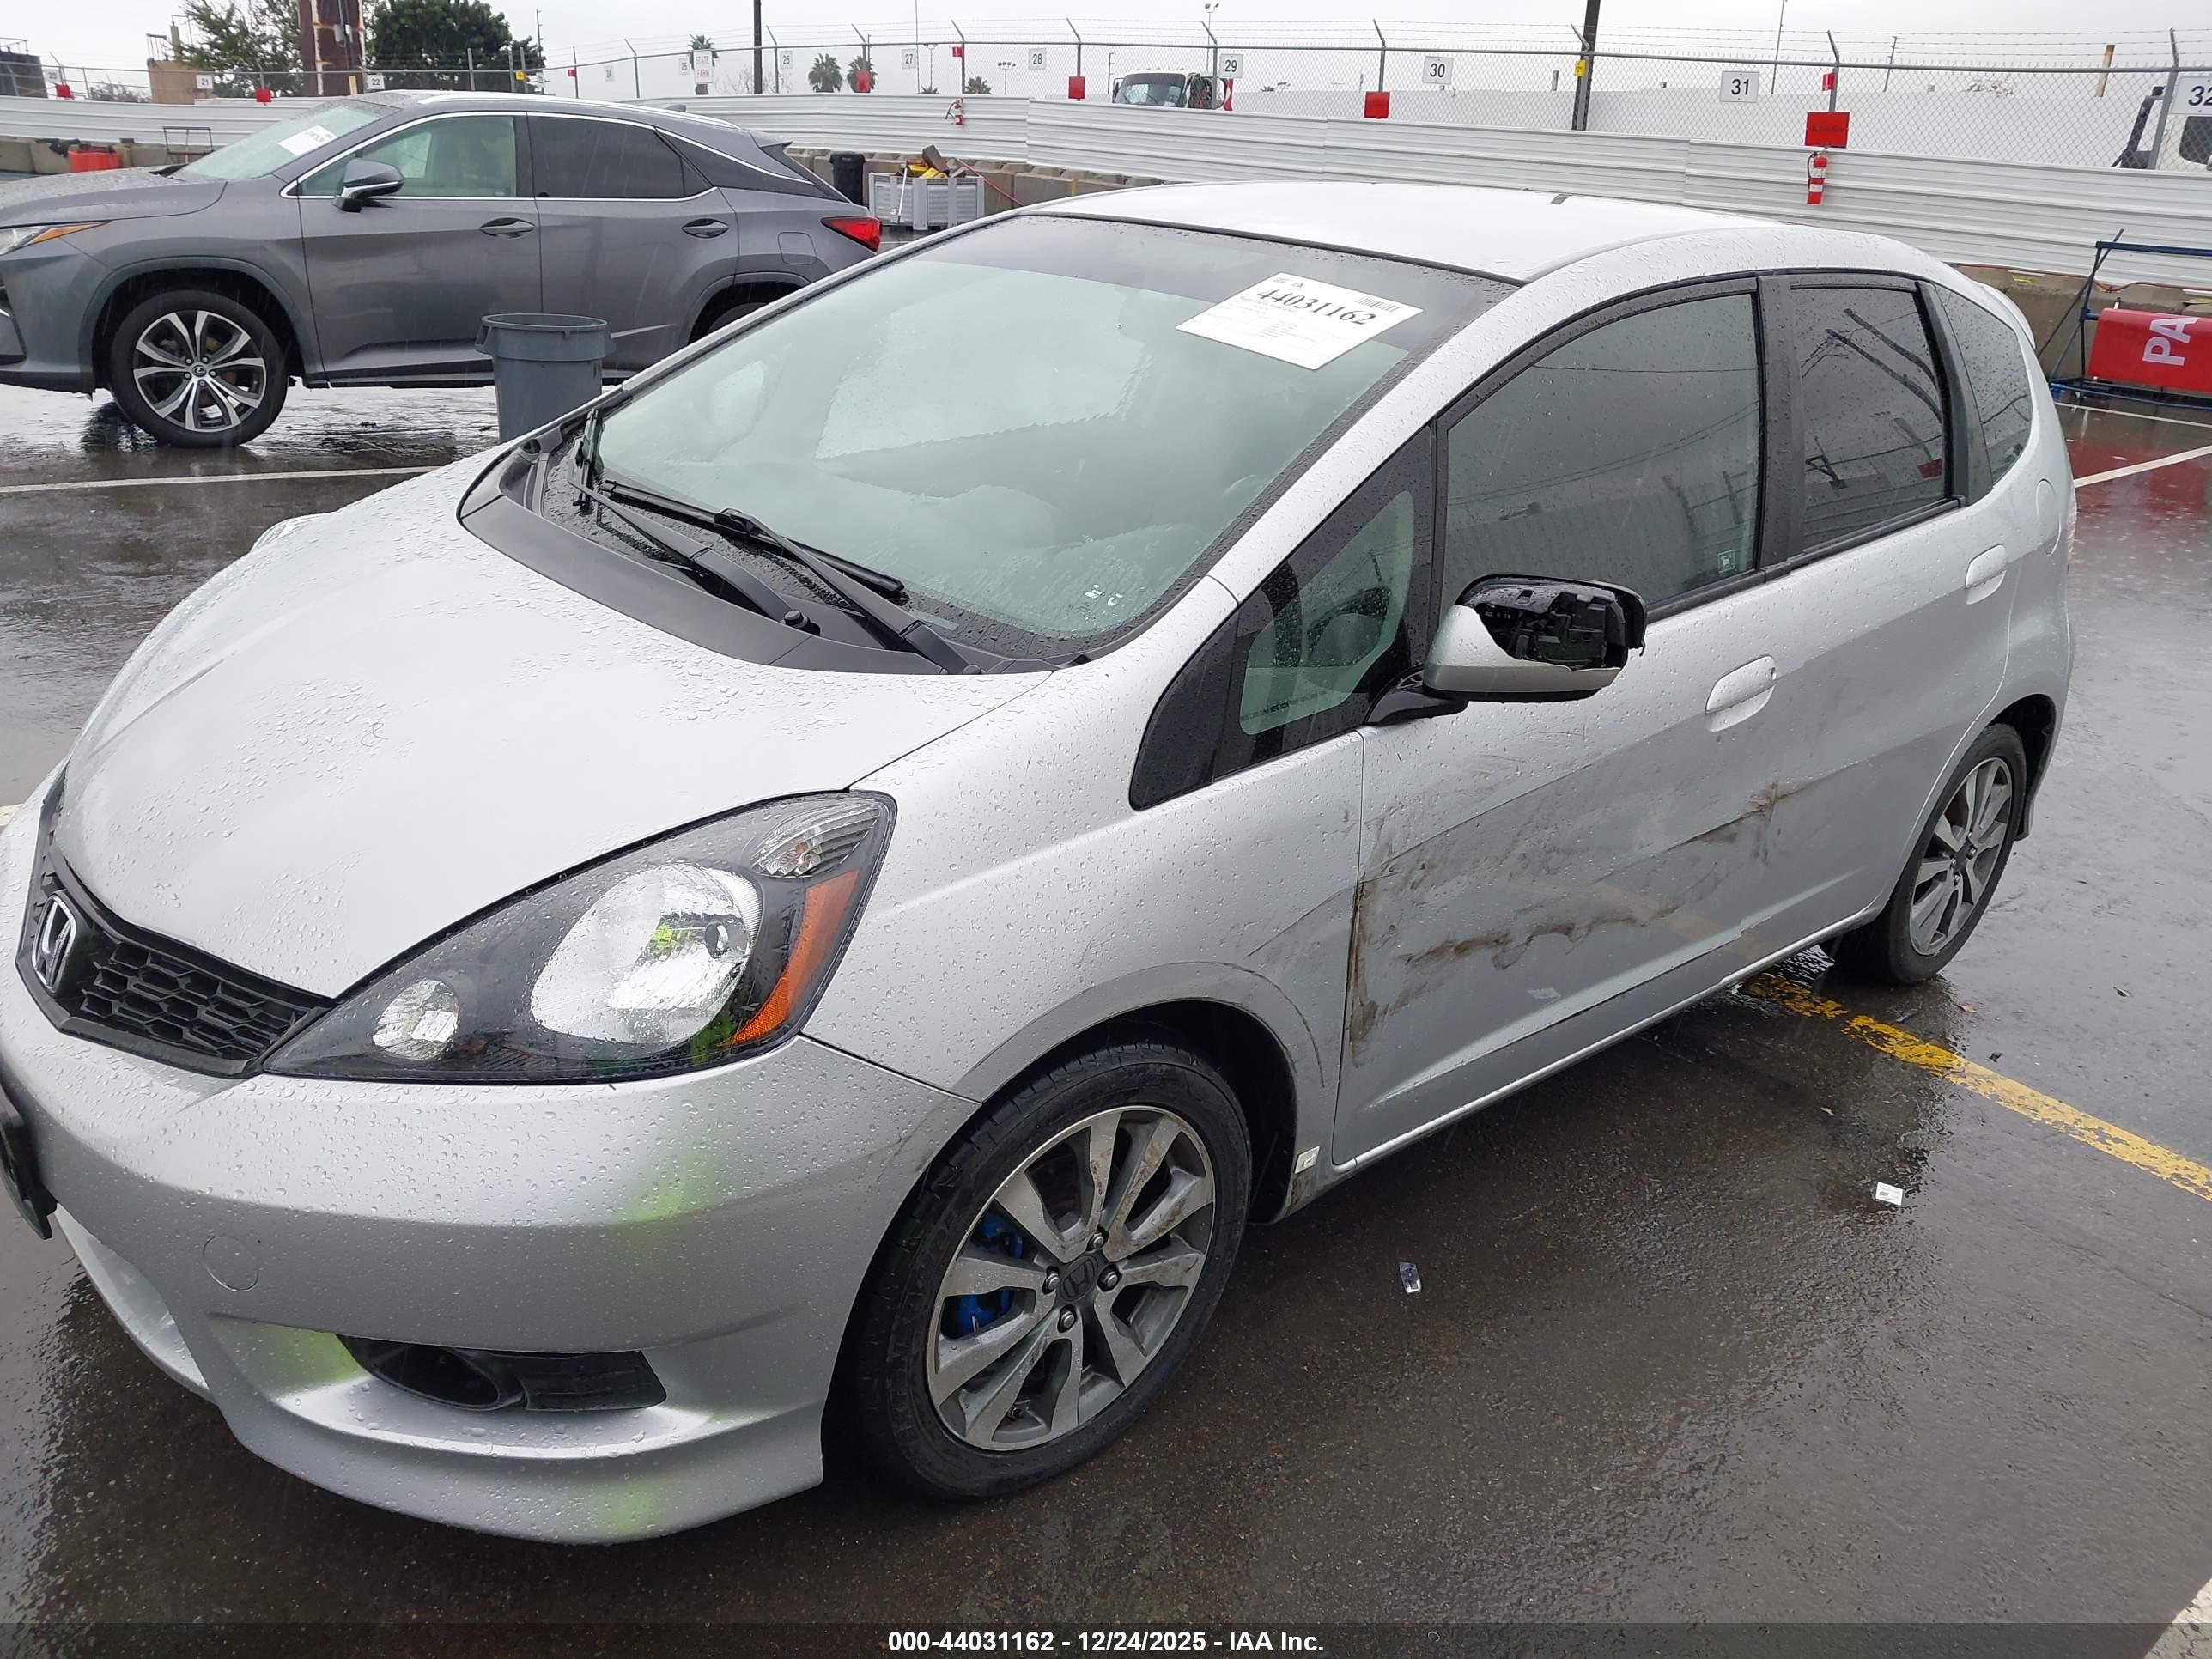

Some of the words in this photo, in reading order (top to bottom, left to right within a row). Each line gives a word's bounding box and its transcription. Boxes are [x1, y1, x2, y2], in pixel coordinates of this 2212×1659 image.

[905, 53, 914, 64] 27
[1033, 53, 1042, 64] 28
[1224, 59, 1237, 73] 29
[1429, 63, 1446, 78] 30
[201, 77, 210, 86] 21
[371, 77, 380, 86] 22
[1730, 78, 1750, 95] 31
[1257, 289, 1376, 325] 44031162
